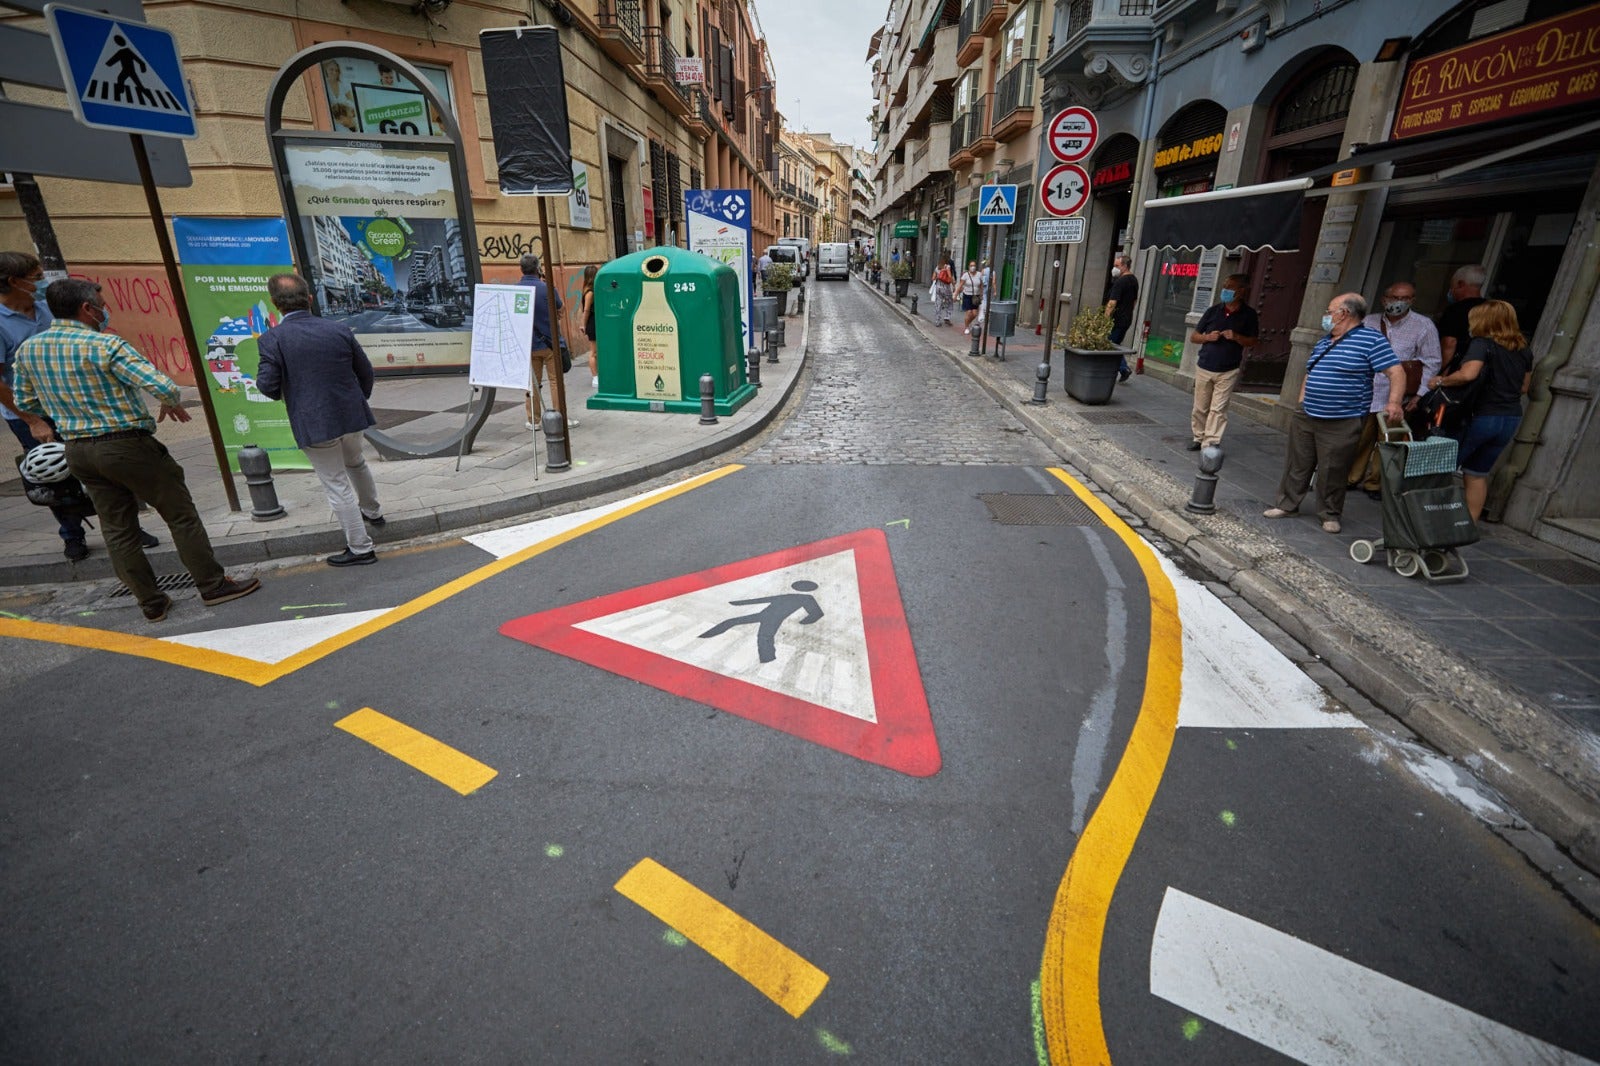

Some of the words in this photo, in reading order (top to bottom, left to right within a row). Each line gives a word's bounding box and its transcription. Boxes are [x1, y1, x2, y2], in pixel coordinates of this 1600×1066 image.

[1468, 93, 1503, 116] ESPECIAS
[1509, 80, 1560, 107] LEGUMBRES
[368, 105, 420, 120] mudanzas
[1189, 133, 1224, 159] JUEGO
[307, 195, 330, 205] ¿Qué
[332, 195, 370, 205] Granada
[371, 196, 404, 207] quieres
[406, 198, 446, 208] respirar?
[674, 282, 696, 293] 245
[636, 323, 674, 333] ecovidrio
[638, 351, 664, 360] REDUCIR
